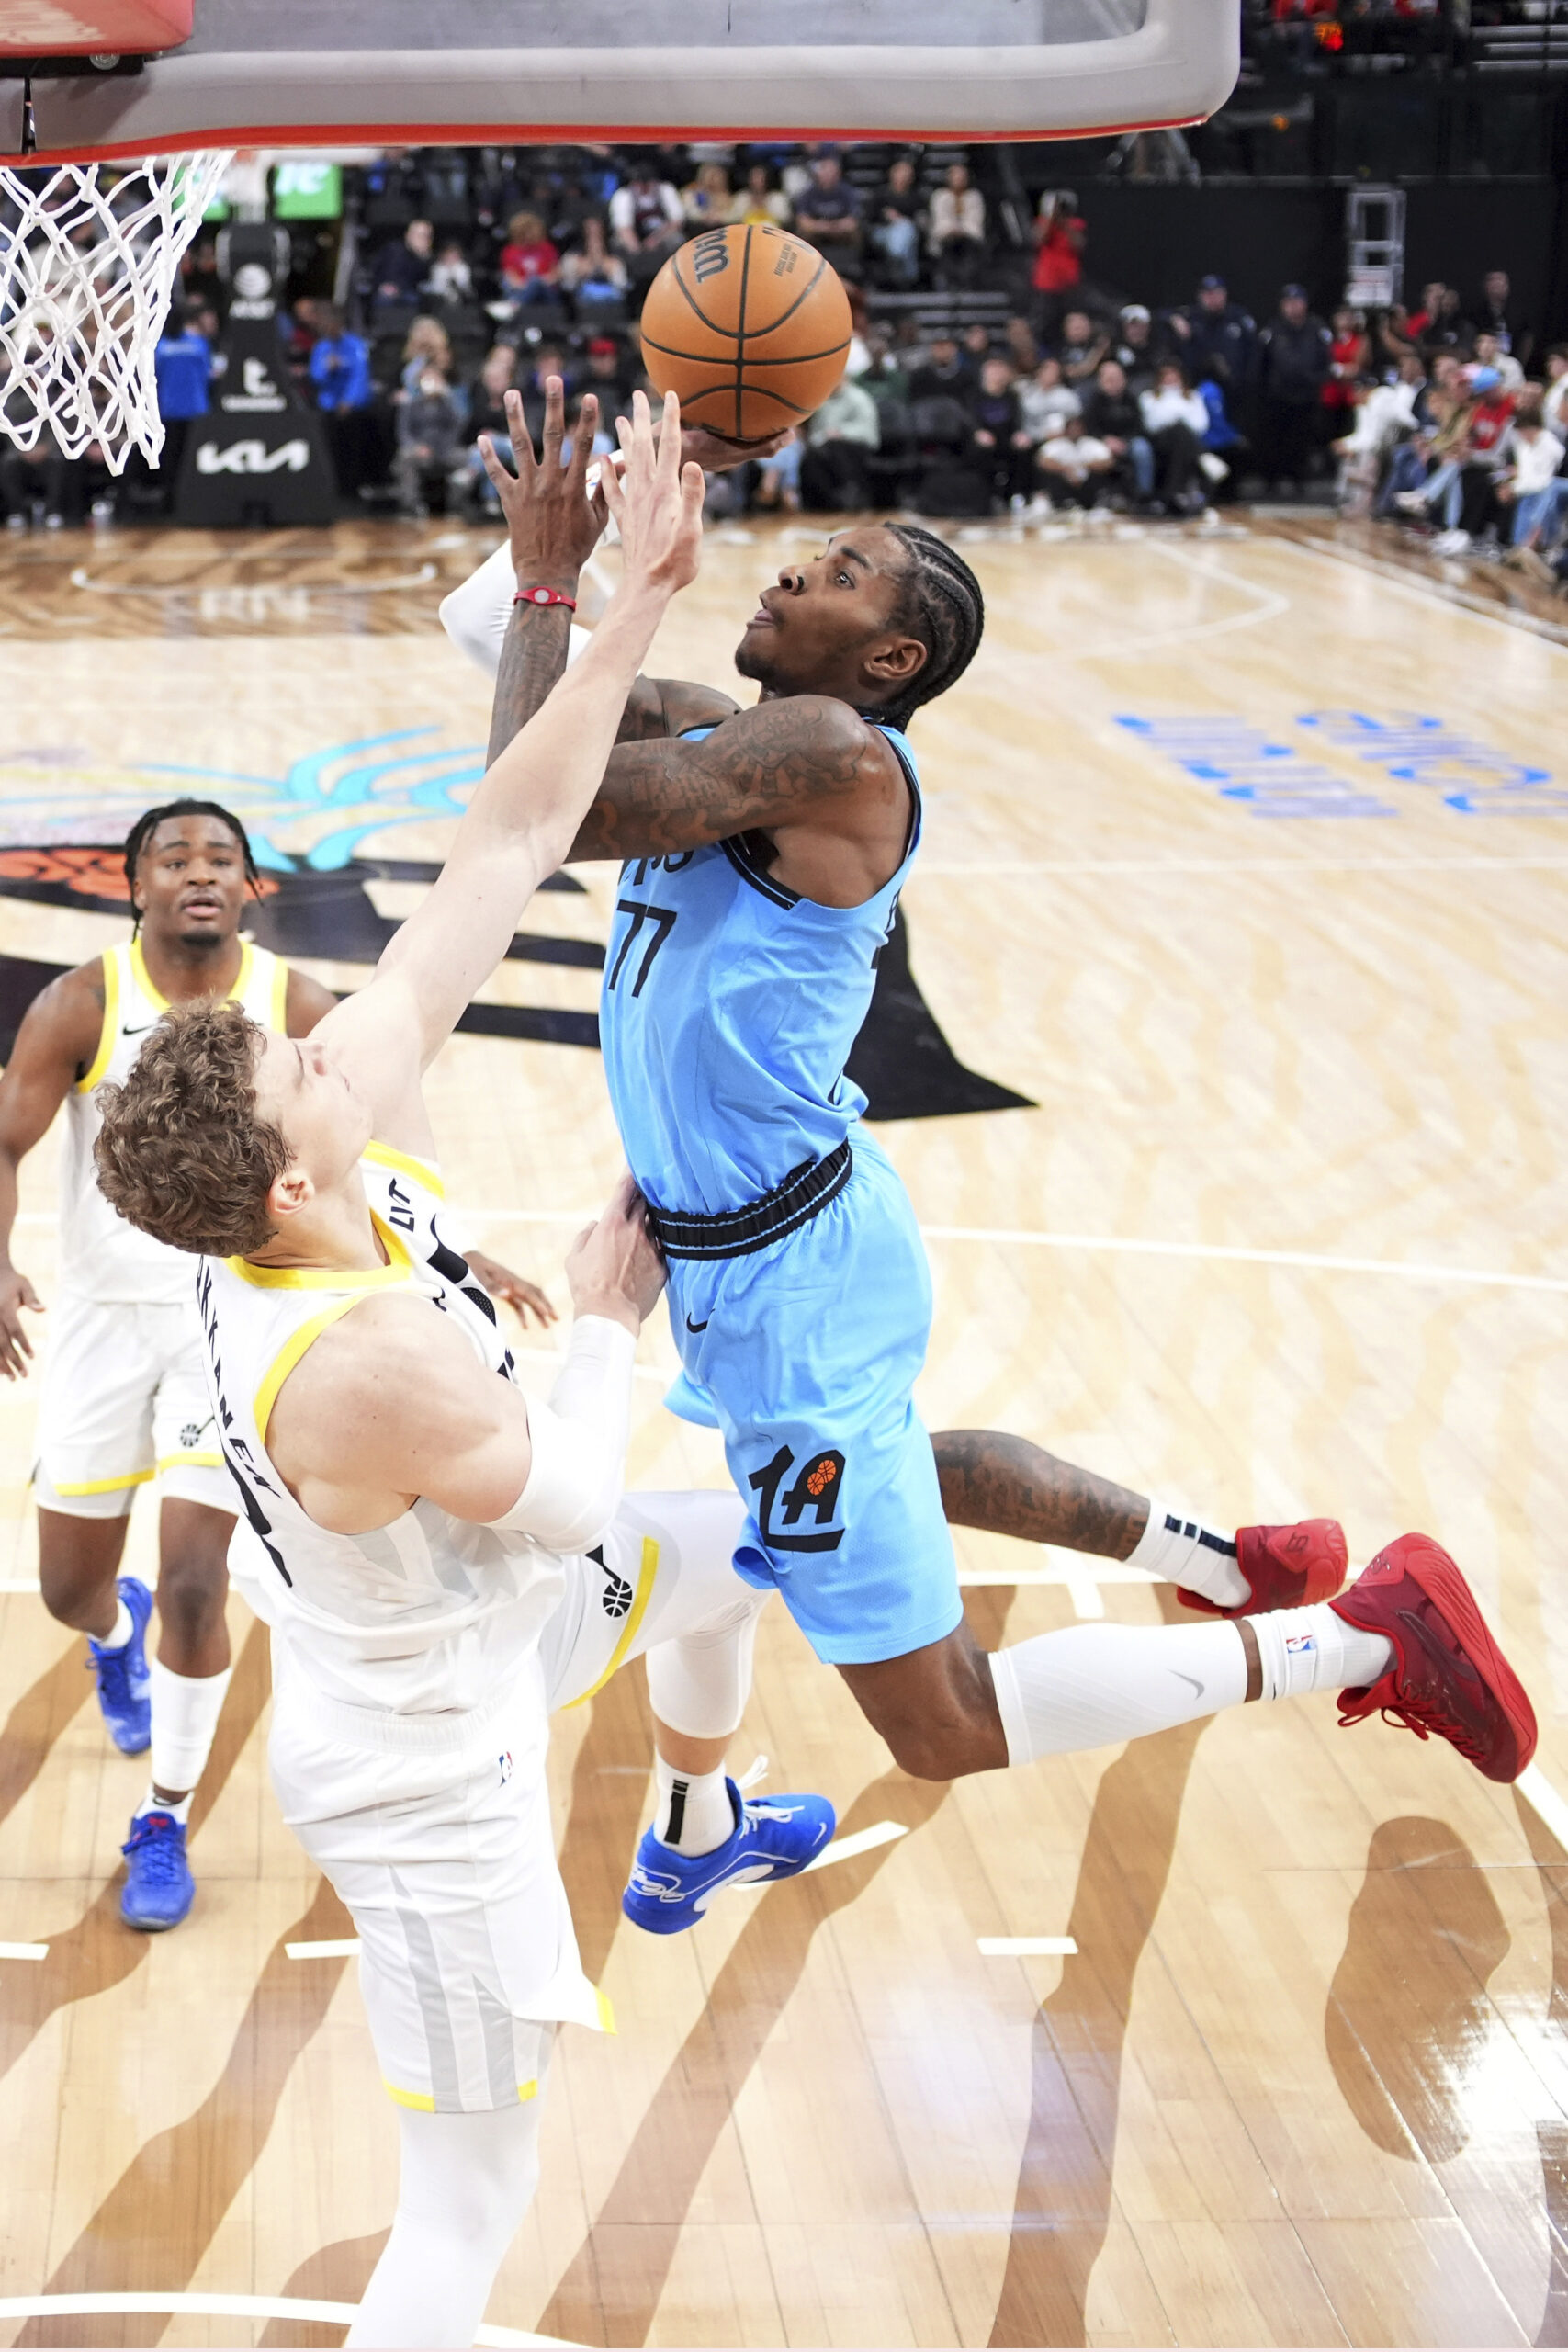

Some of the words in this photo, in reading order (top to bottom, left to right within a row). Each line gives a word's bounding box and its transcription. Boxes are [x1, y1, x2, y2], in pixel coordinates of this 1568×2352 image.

[608, 899, 678, 999] 77
[197, 1254, 282, 1499] RKKANEN
[748, 1444, 846, 1553] LA
